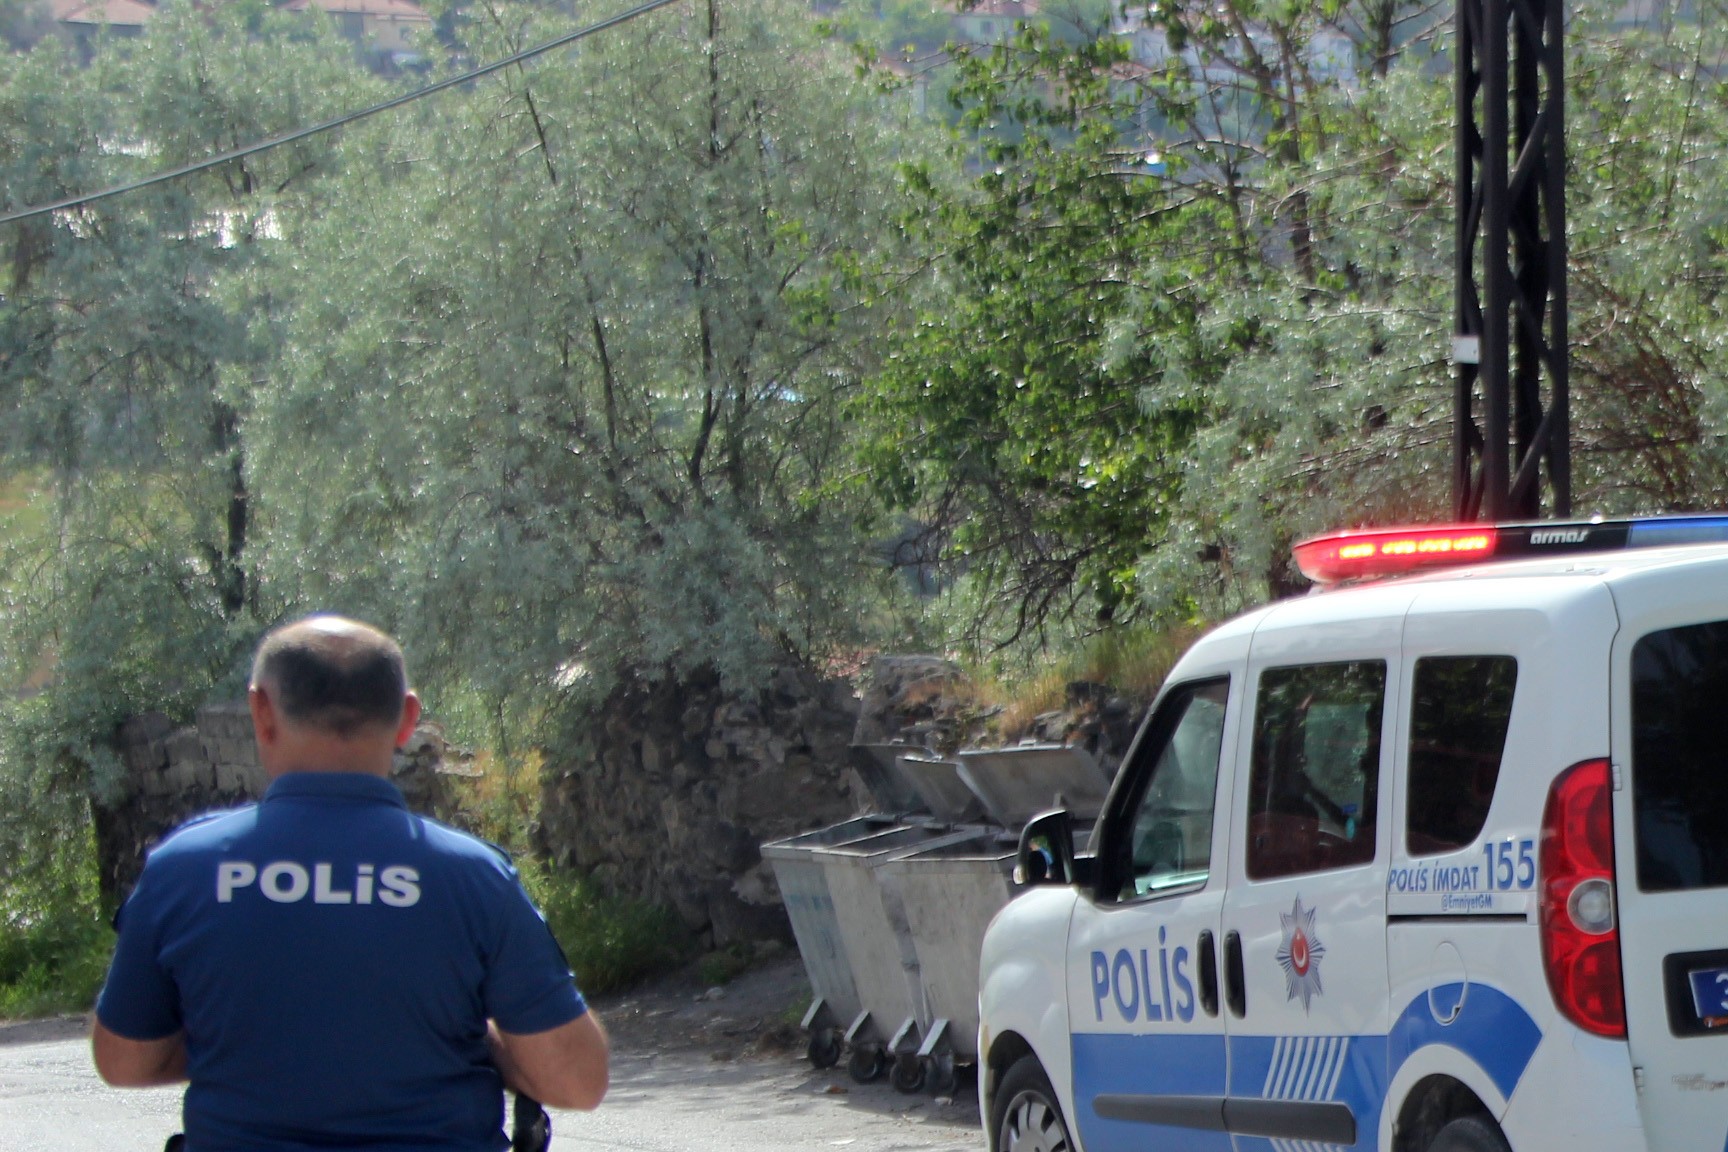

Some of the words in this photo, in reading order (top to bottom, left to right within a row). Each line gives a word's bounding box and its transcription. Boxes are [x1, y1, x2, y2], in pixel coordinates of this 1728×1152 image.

[1388, 860, 1429, 893] POLİS
[1432, 860, 1479, 892] İMDAT
[1483, 840, 1535, 891] 155
